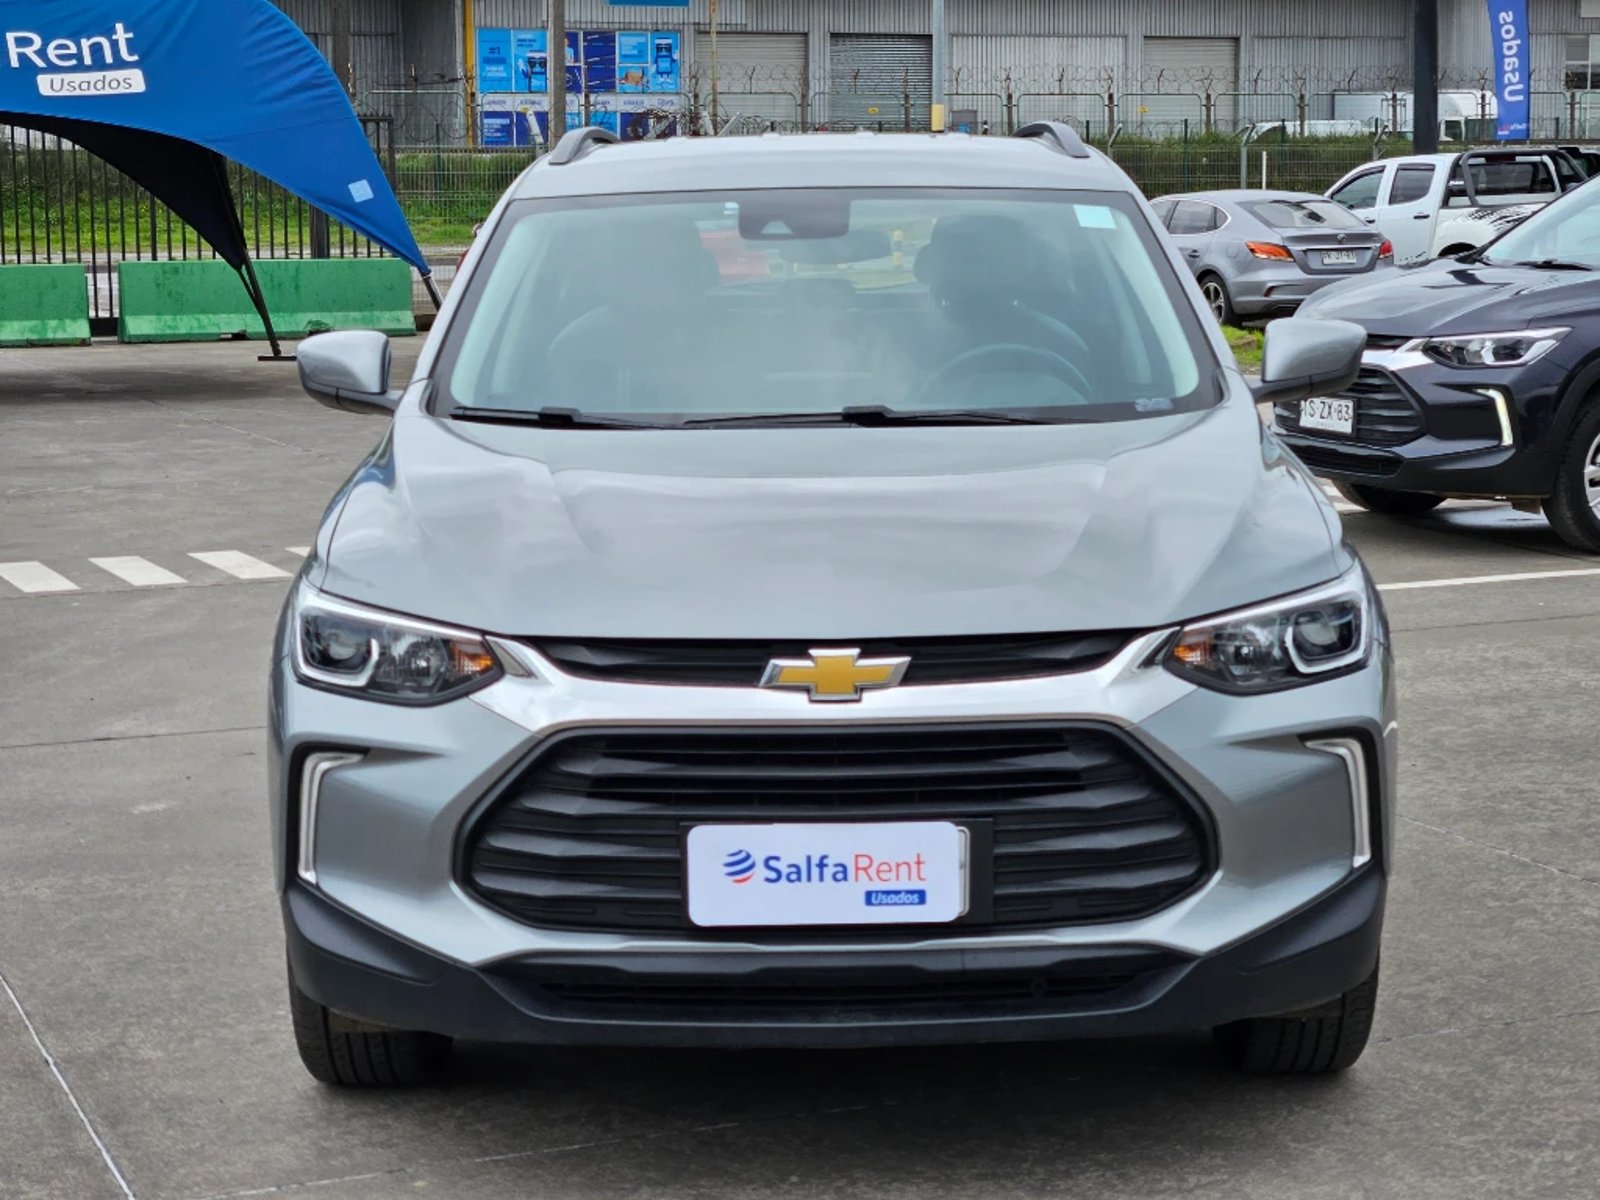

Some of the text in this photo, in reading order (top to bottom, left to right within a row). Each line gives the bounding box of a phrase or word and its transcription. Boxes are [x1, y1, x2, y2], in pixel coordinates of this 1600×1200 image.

[5, 23, 139, 68] Rent
[49, 75, 133, 92] Usados
[763, 852, 927, 884] SalfaRent
[871, 890, 920, 905] Usados
